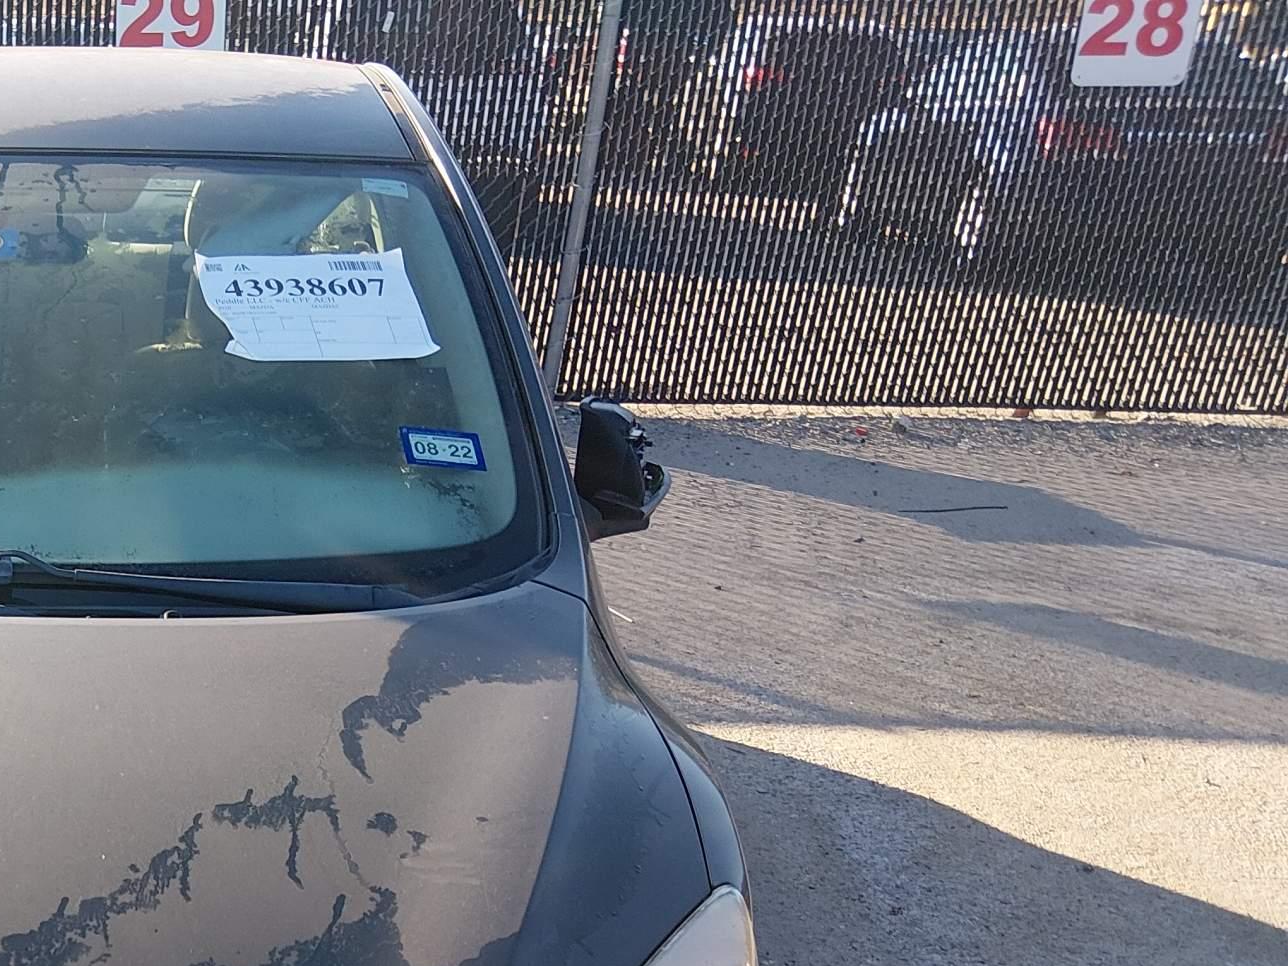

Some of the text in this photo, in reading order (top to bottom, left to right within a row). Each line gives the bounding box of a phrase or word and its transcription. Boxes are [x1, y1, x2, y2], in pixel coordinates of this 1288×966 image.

[119, 0, 214, 47] 29
[1079, 0, 1188, 57] 28
[225, 277, 384, 297] 43938607
